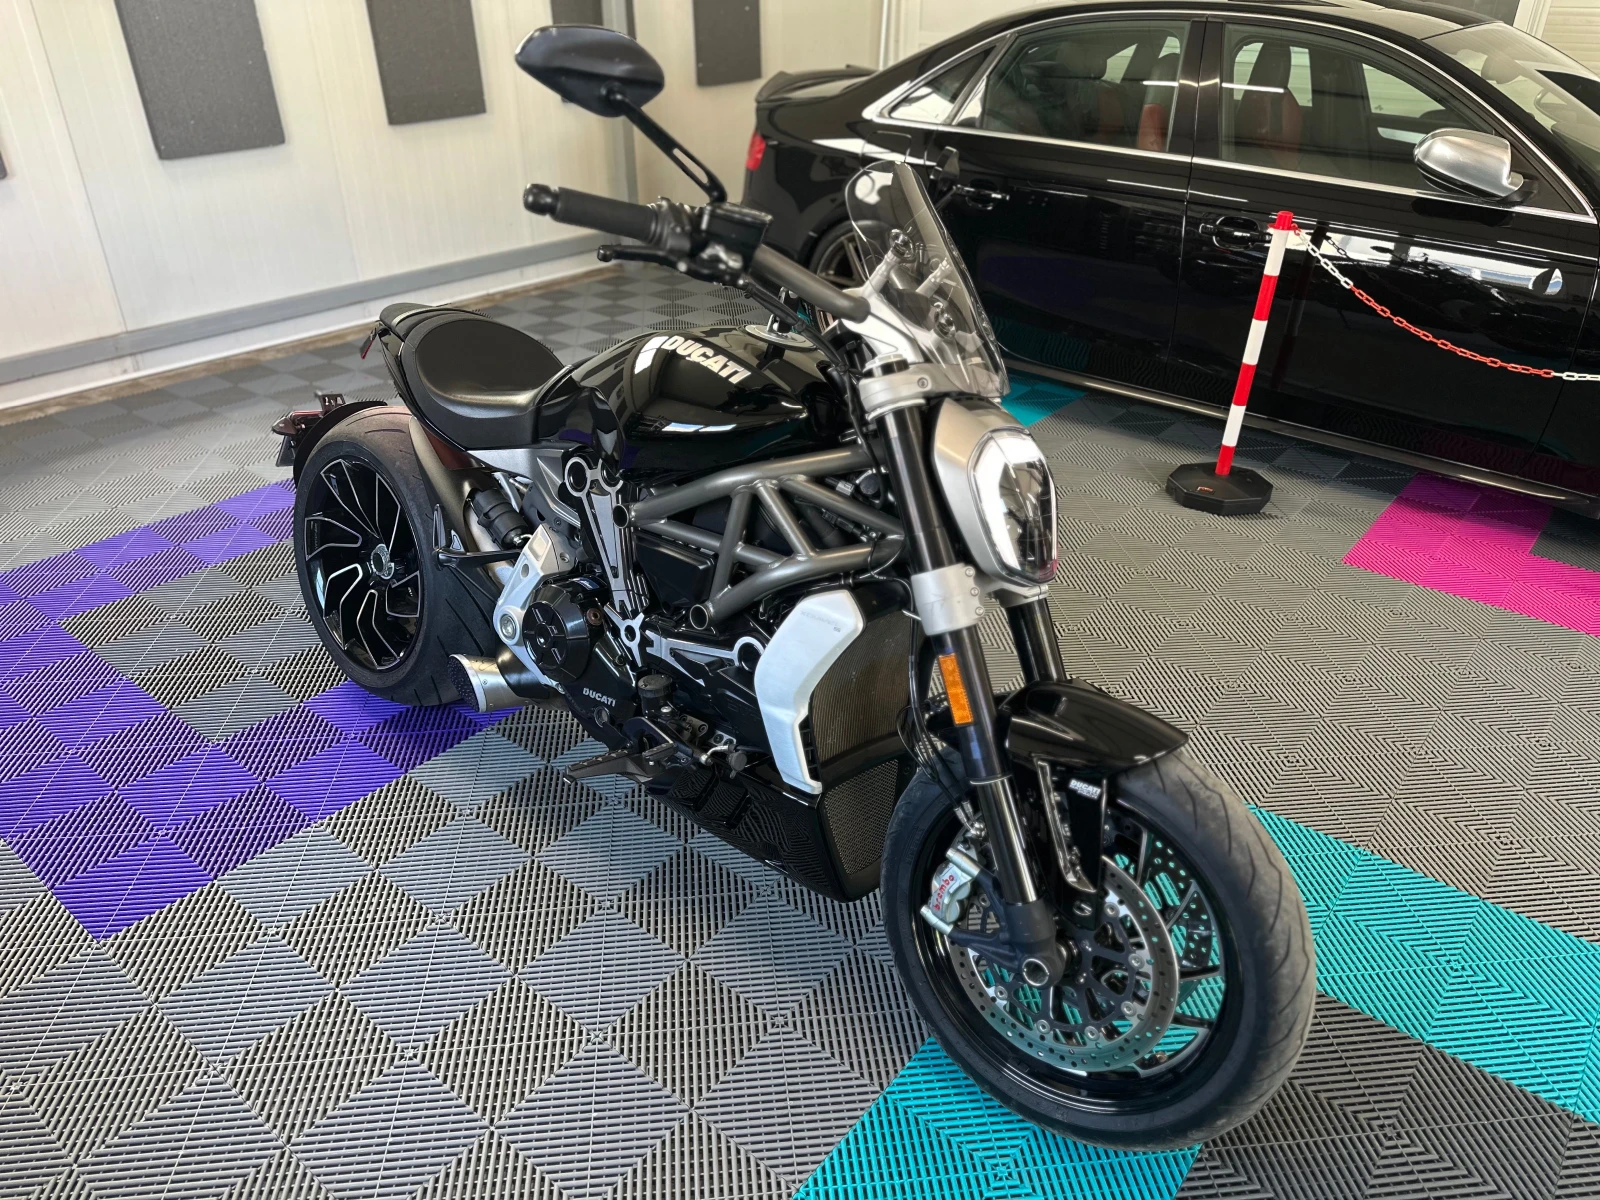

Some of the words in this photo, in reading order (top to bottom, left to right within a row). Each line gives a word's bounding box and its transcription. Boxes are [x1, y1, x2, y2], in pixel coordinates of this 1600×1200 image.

[661, 335, 751, 384] DUCATI
[582, 687, 616, 707] DUCATI
[1070, 779, 1101, 795] DUCATI
[933, 874, 955, 911] brembo
